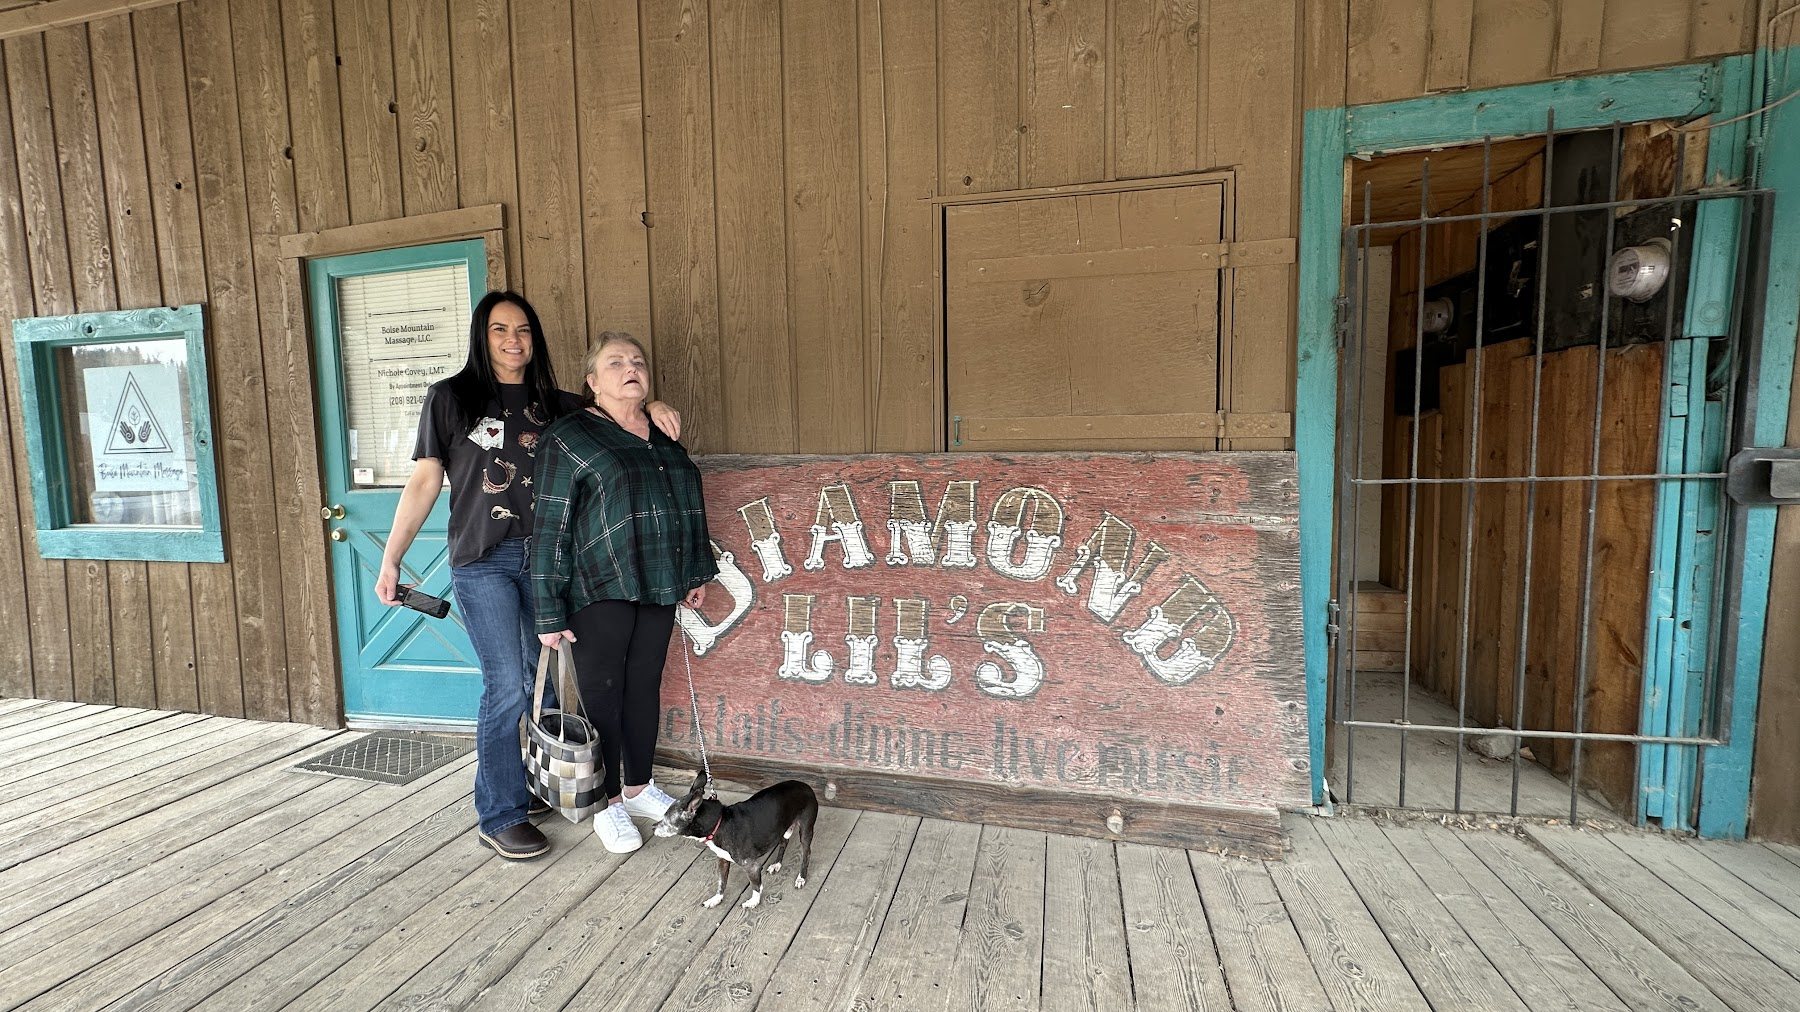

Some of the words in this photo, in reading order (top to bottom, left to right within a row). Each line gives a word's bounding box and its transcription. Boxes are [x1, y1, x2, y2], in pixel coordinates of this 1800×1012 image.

[381, 326, 399, 334] Boise
[400, 323, 434, 332] Mountain
[385, 337, 416, 345] Massage,
[378, 369, 403, 377] Nichole
[404, 368, 428, 376] Covey,
[429, 366, 445, 375] LMT
[390, 396, 405, 406] (208)
[675, 479, 1236, 685] DIAMOND
